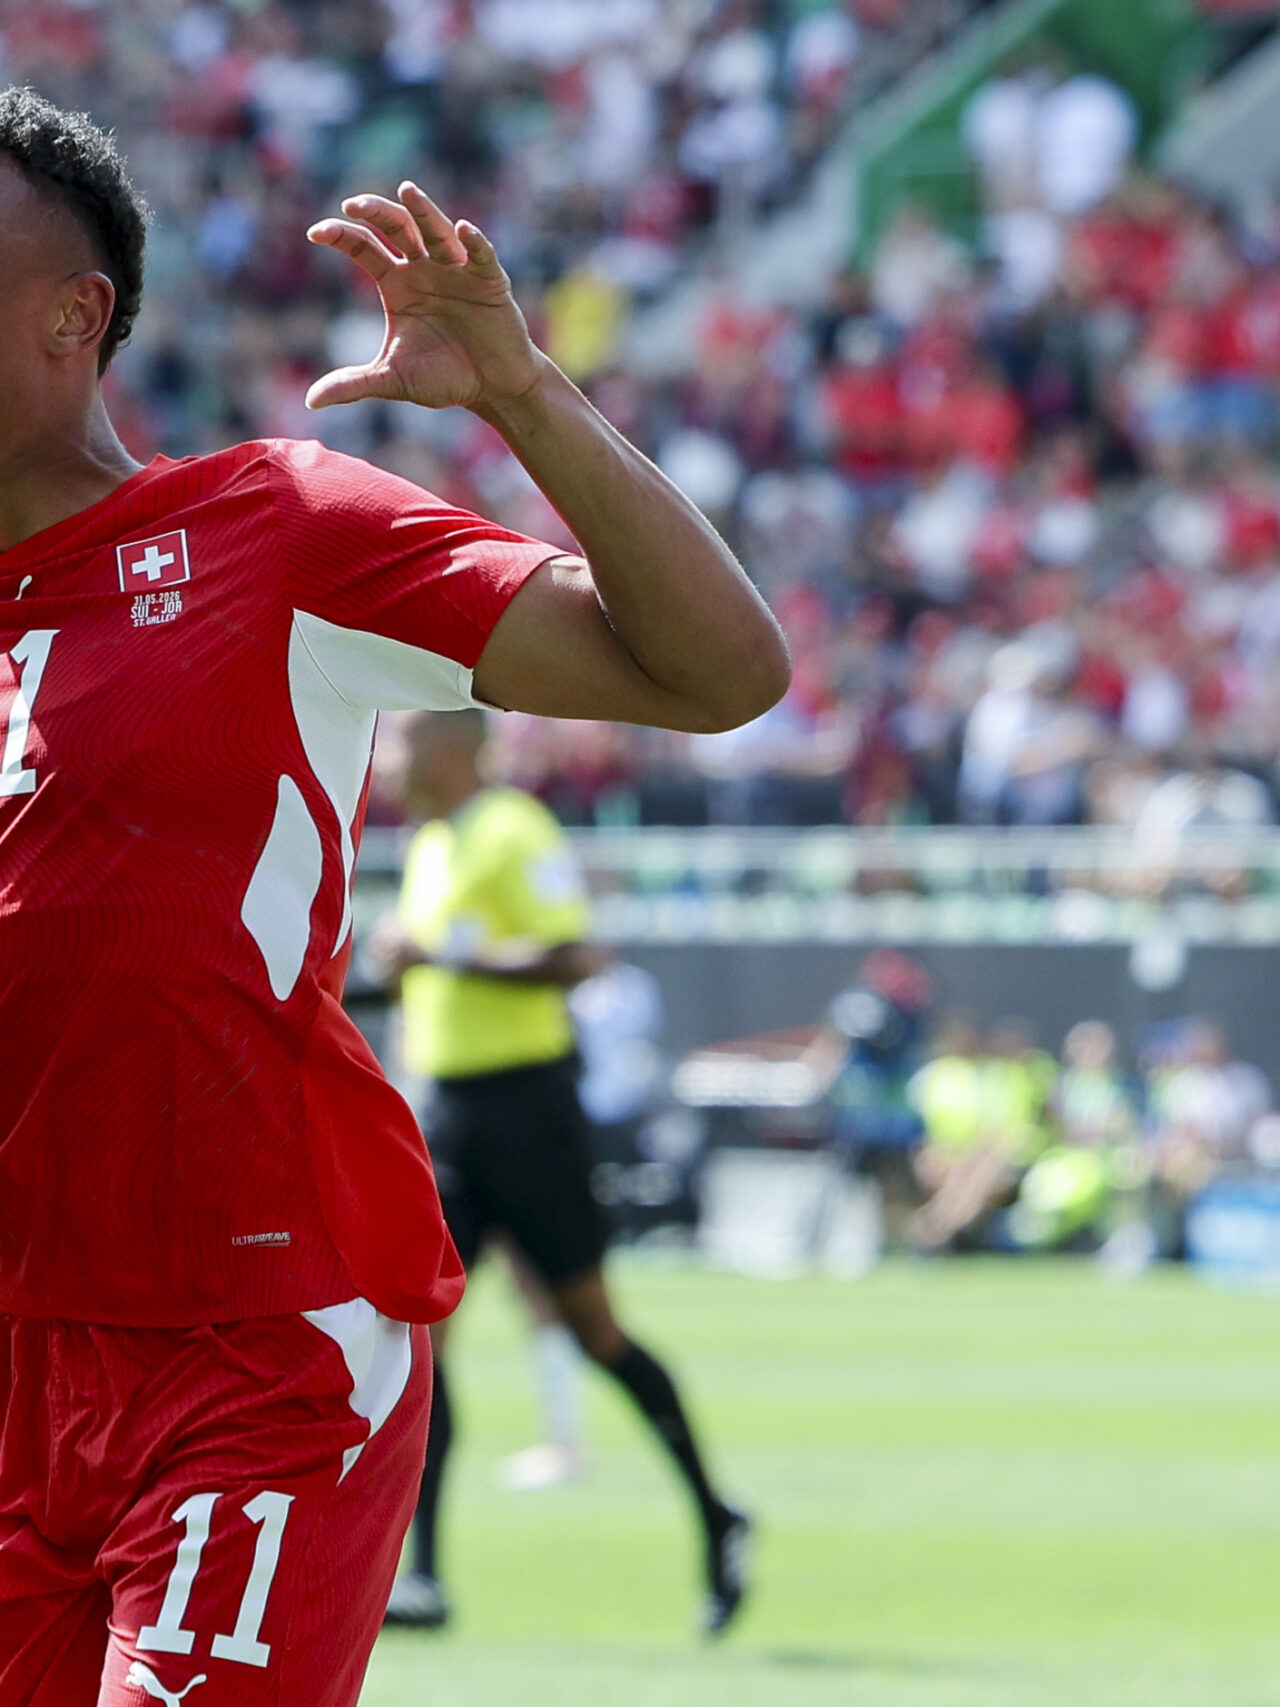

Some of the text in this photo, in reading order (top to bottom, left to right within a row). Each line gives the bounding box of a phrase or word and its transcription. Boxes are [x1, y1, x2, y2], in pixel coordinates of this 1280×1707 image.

[130, 605, 150, 619] SUI
[161, 600, 183, 614] JOR
[135, 1490, 296, 1668] 11
